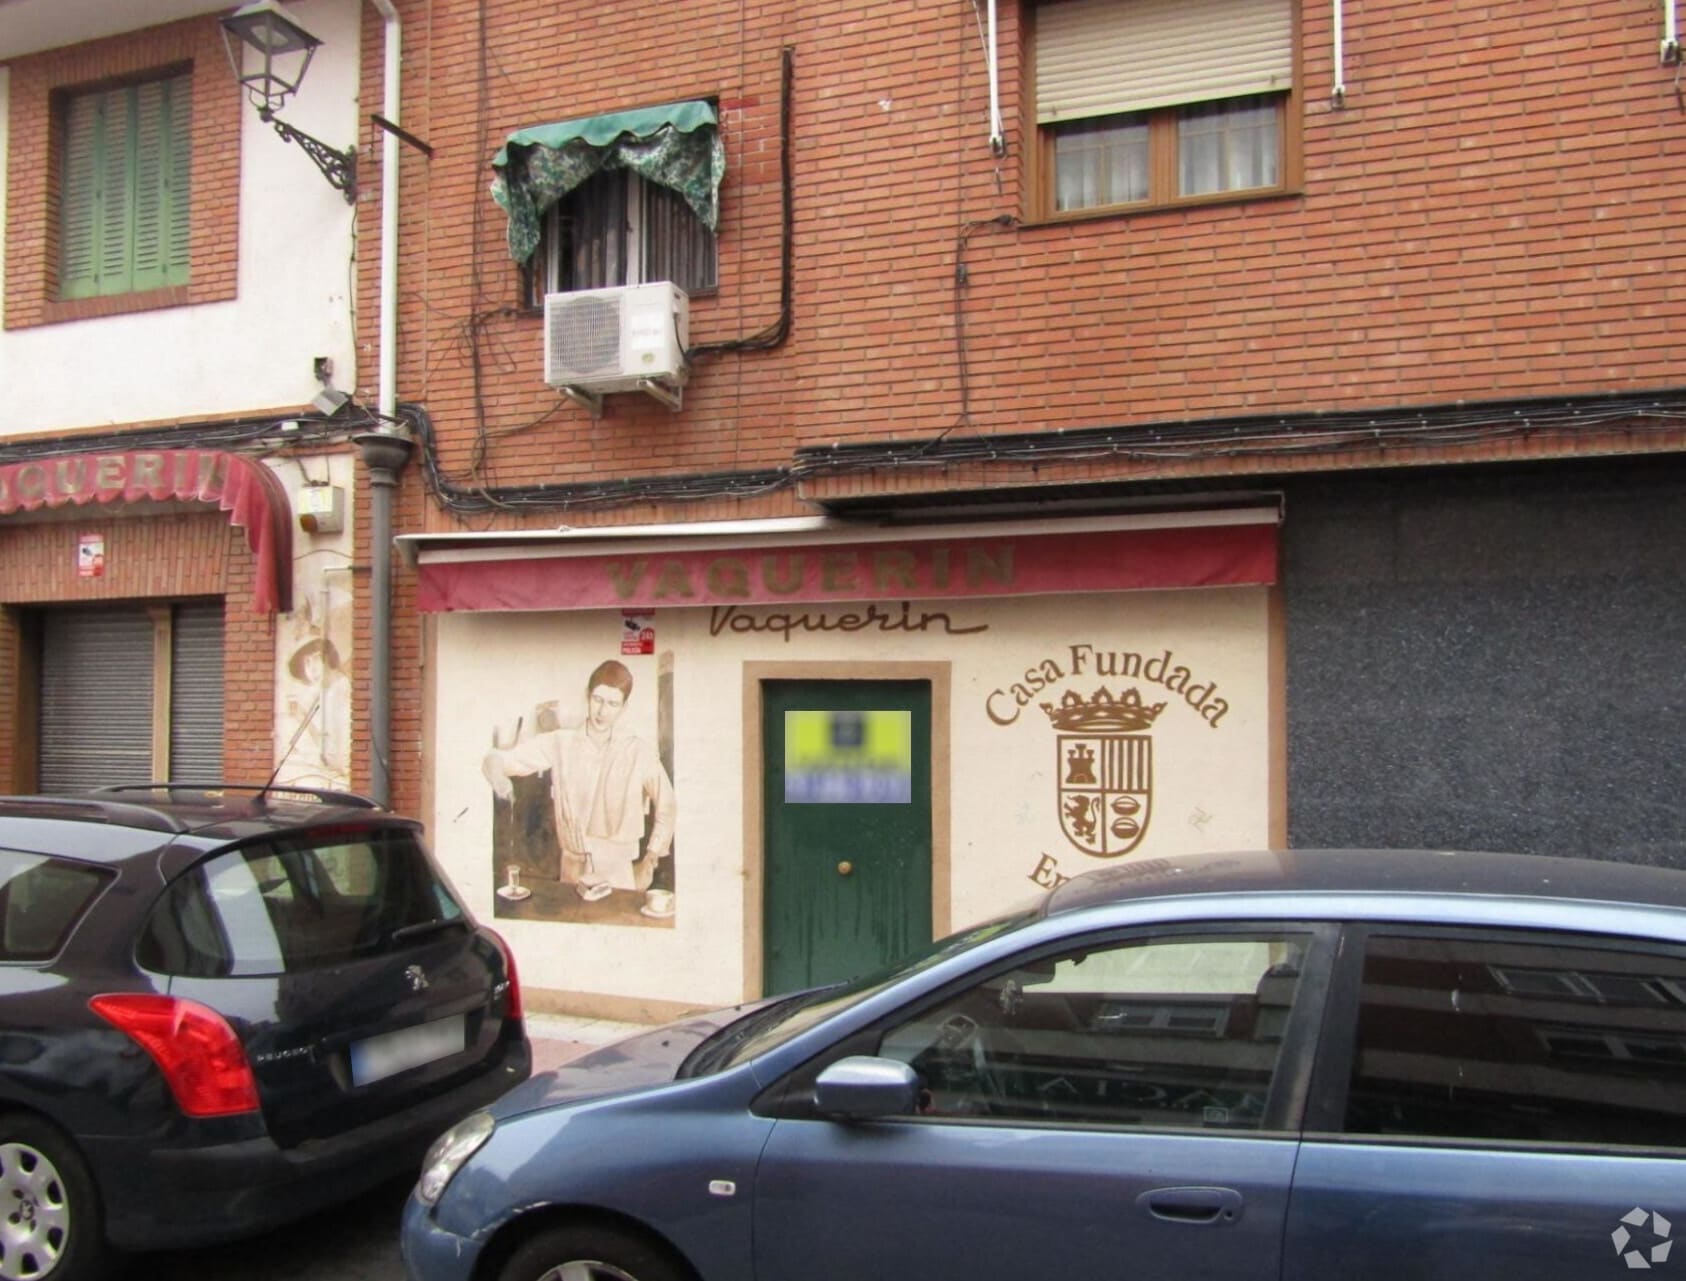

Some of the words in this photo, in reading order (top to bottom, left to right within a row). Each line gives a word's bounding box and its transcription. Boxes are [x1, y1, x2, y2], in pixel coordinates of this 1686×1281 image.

[0, 454, 228, 497] QUERIN
[605, 547, 1015, 599] VAQUERIN
[709, 602, 989, 641] Vaquerin
[986, 658, 1064, 726] Casa
[1069, 644, 1229, 729] Fundada
